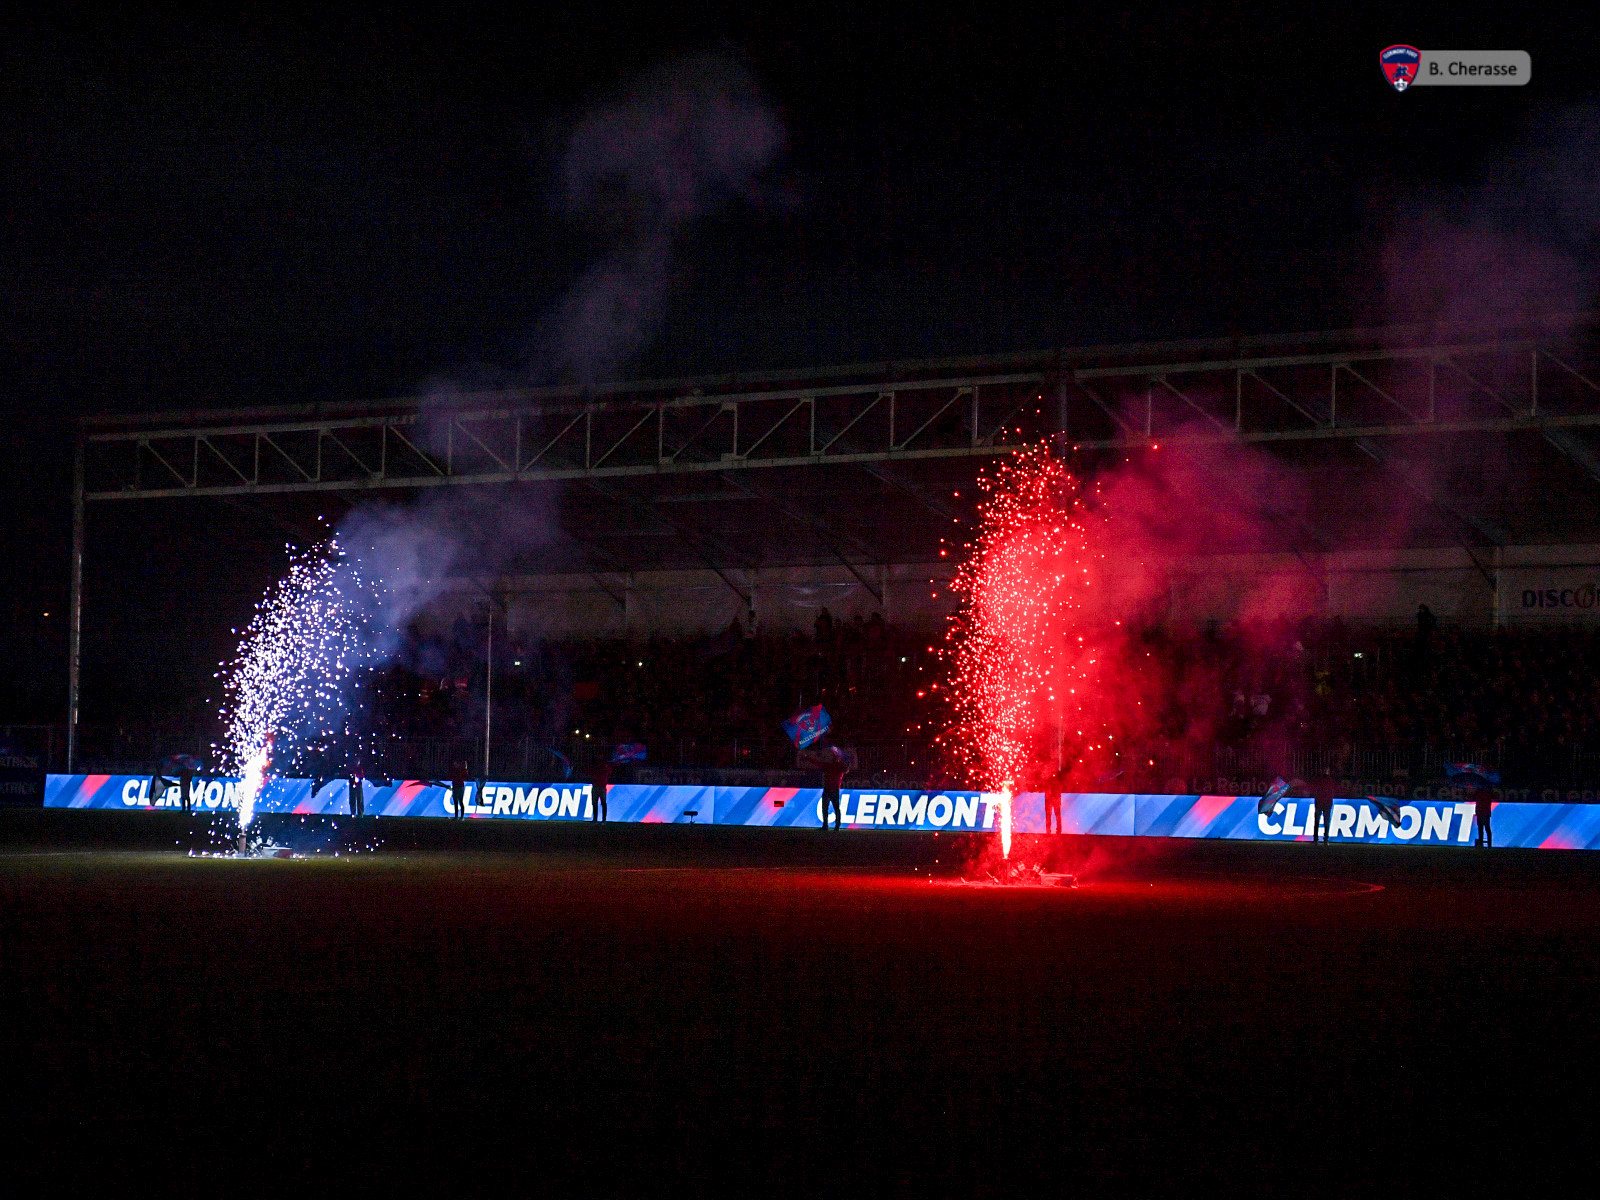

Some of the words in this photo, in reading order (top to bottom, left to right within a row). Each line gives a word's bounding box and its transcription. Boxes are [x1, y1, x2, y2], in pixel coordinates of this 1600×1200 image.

[1522, 584, 1600, 608] DISCO
[122, 779, 246, 808] CLERMON
[1217, 776, 1269, 796] Régio
